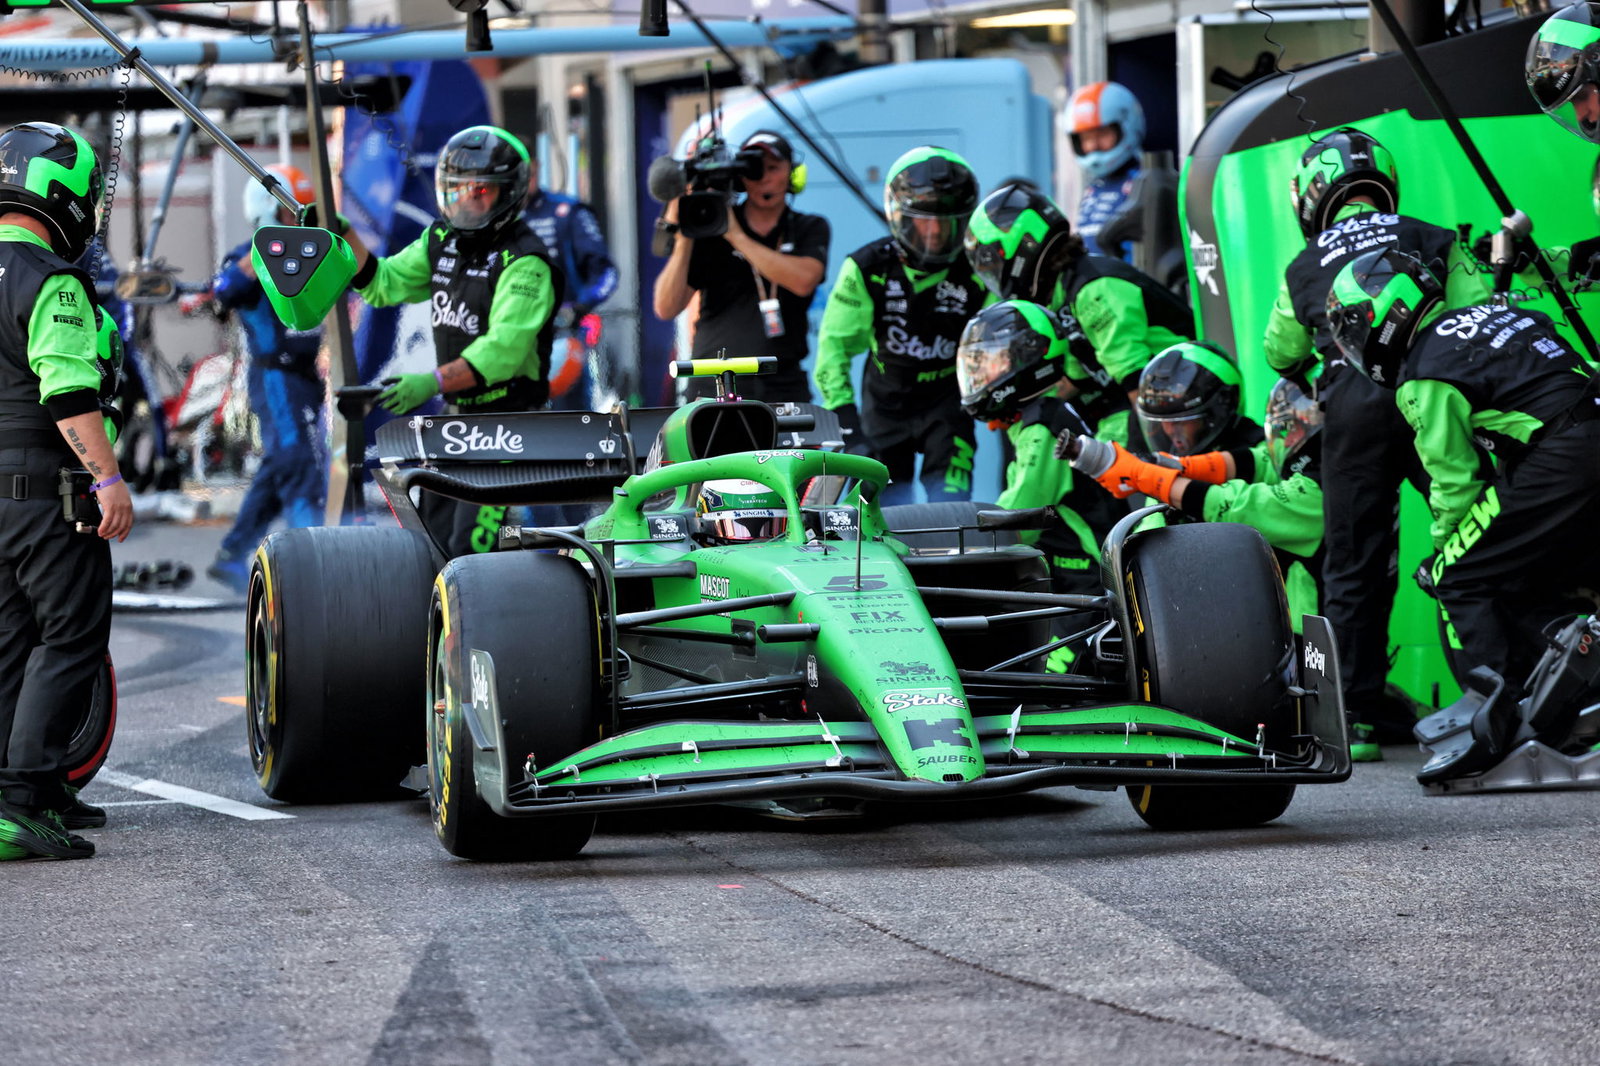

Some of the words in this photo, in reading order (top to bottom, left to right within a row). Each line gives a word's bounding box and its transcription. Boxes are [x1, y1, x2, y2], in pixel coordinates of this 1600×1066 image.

[58, 291, 77, 303] FIX
[432, 290, 480, 335] Stake
[441, 420, 524, 455] Stake
[755, 449, 806, 464] Stake
[652, 532, 687, 540] SINGHA
[700, 573, 731, 600] MASCOT
[823, 573, 888, 592] 5
[850, 610, 906, 621] FIX
[848, 627, 926, 636] PicPay
[1305, 641, 1325, 677] PicPay
[472, 654, 489, 711] Stake
[876, 675, 956, 683] SINGHA
[883, 692, 967, 714] Stake
[917, 755, 978, 769] SAUBER
